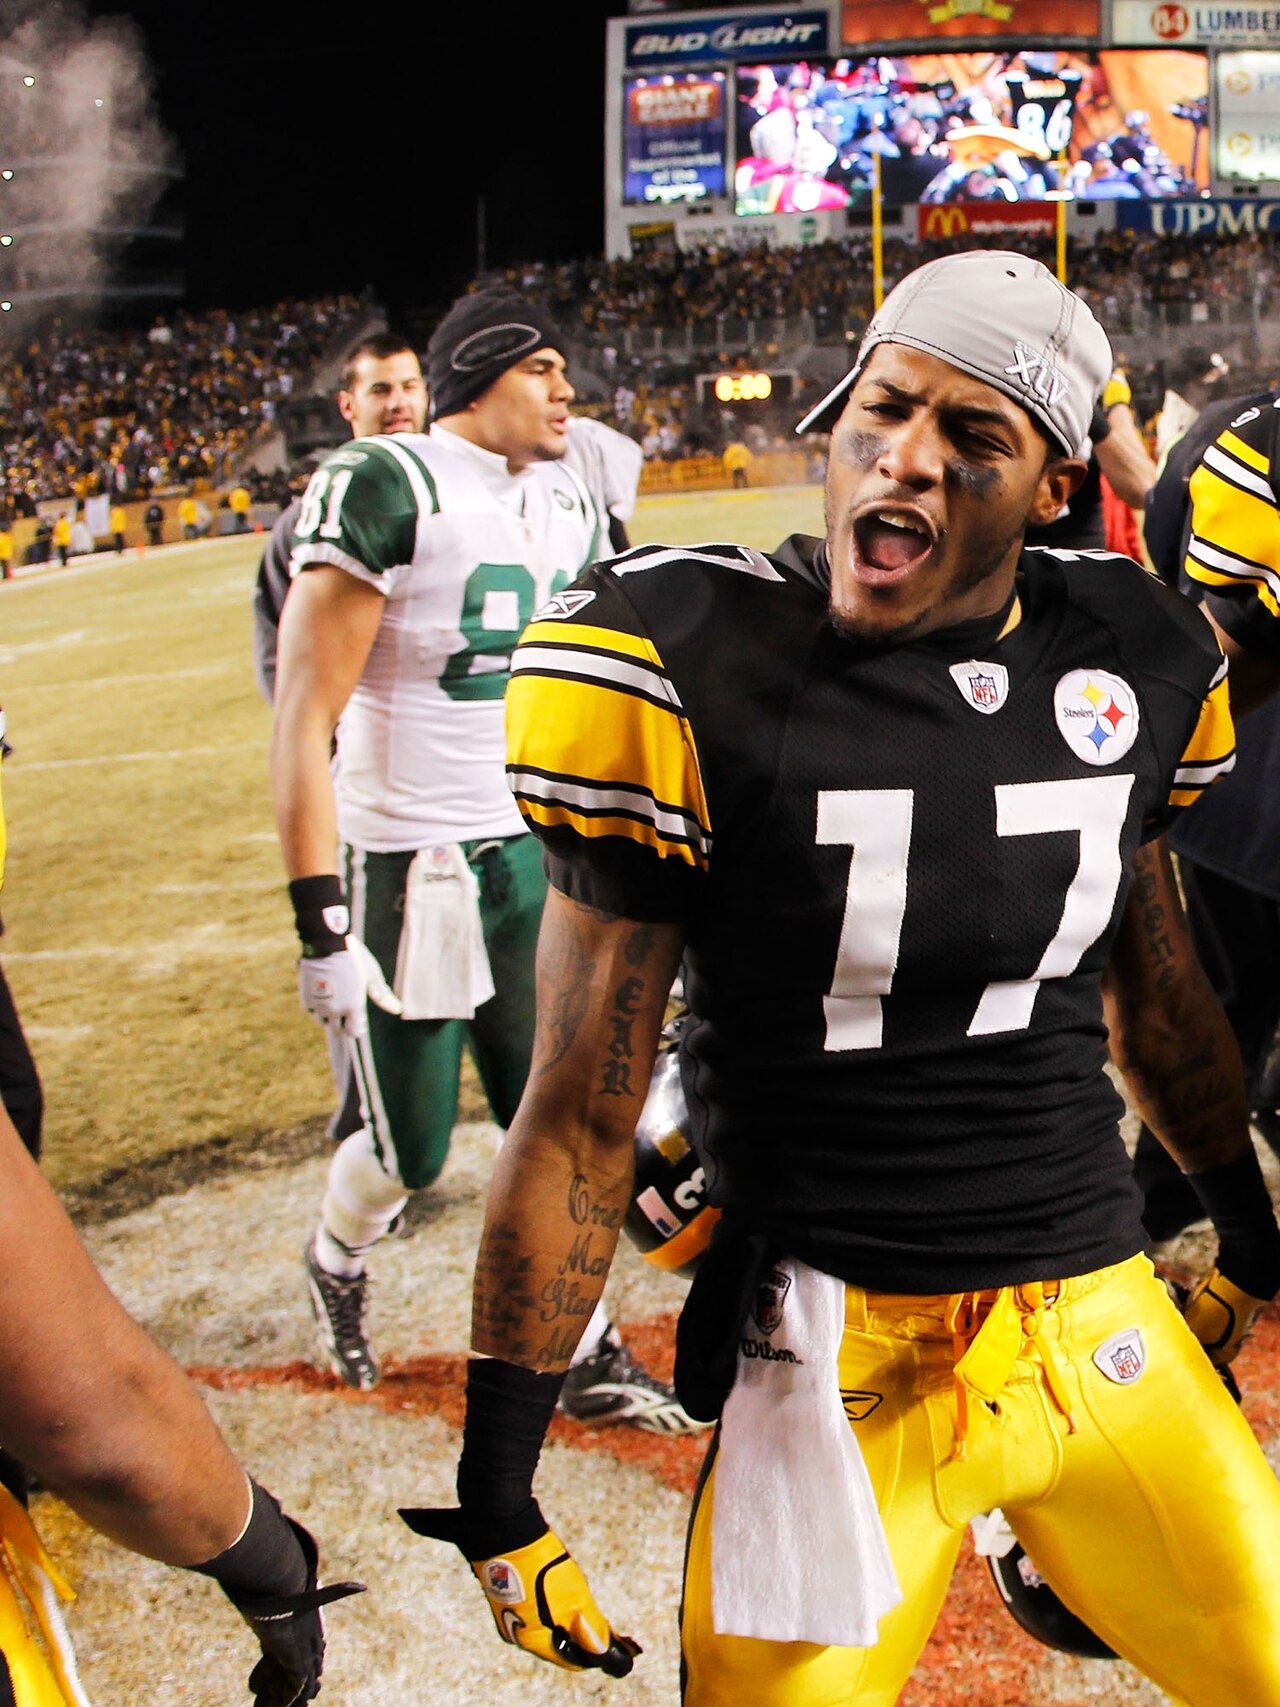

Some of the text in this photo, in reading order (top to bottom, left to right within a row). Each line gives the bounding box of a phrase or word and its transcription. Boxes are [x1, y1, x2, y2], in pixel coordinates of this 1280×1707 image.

[632, 23, 821, 55] BUD LIGHT
[636, 84, 715, 108] GIANT
[294, 469, 353, 540] 81
[1063, 706, 1095, 719] Steelers
[814, 774, 1136, 1053] 17
[567, 1172, 620, 1229] One
